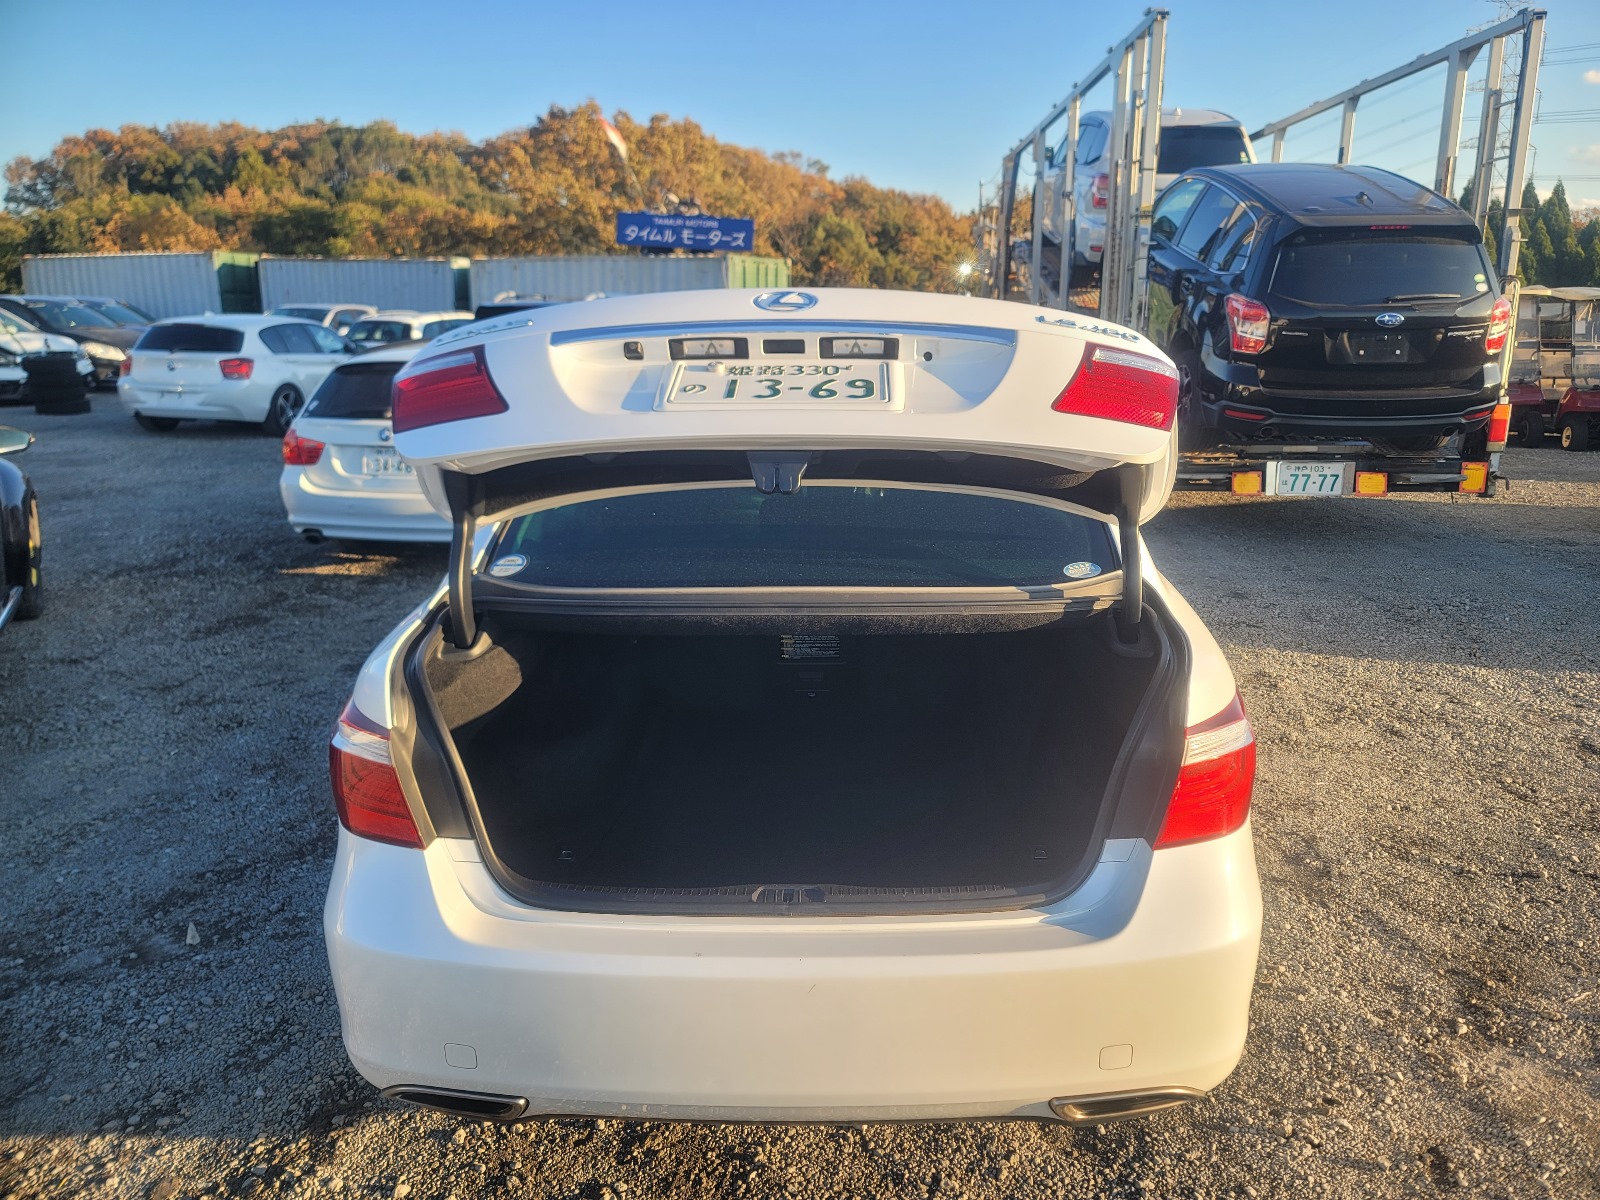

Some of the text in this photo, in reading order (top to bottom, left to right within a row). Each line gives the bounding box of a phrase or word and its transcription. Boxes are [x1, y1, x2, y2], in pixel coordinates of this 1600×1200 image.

[685, 219, 719, 228] MOTORS
[625, 224, 677, 243] タイムル
[683, 378, 875, 399] の 13-69
[1290, 473, 1340, 492] 77-77
